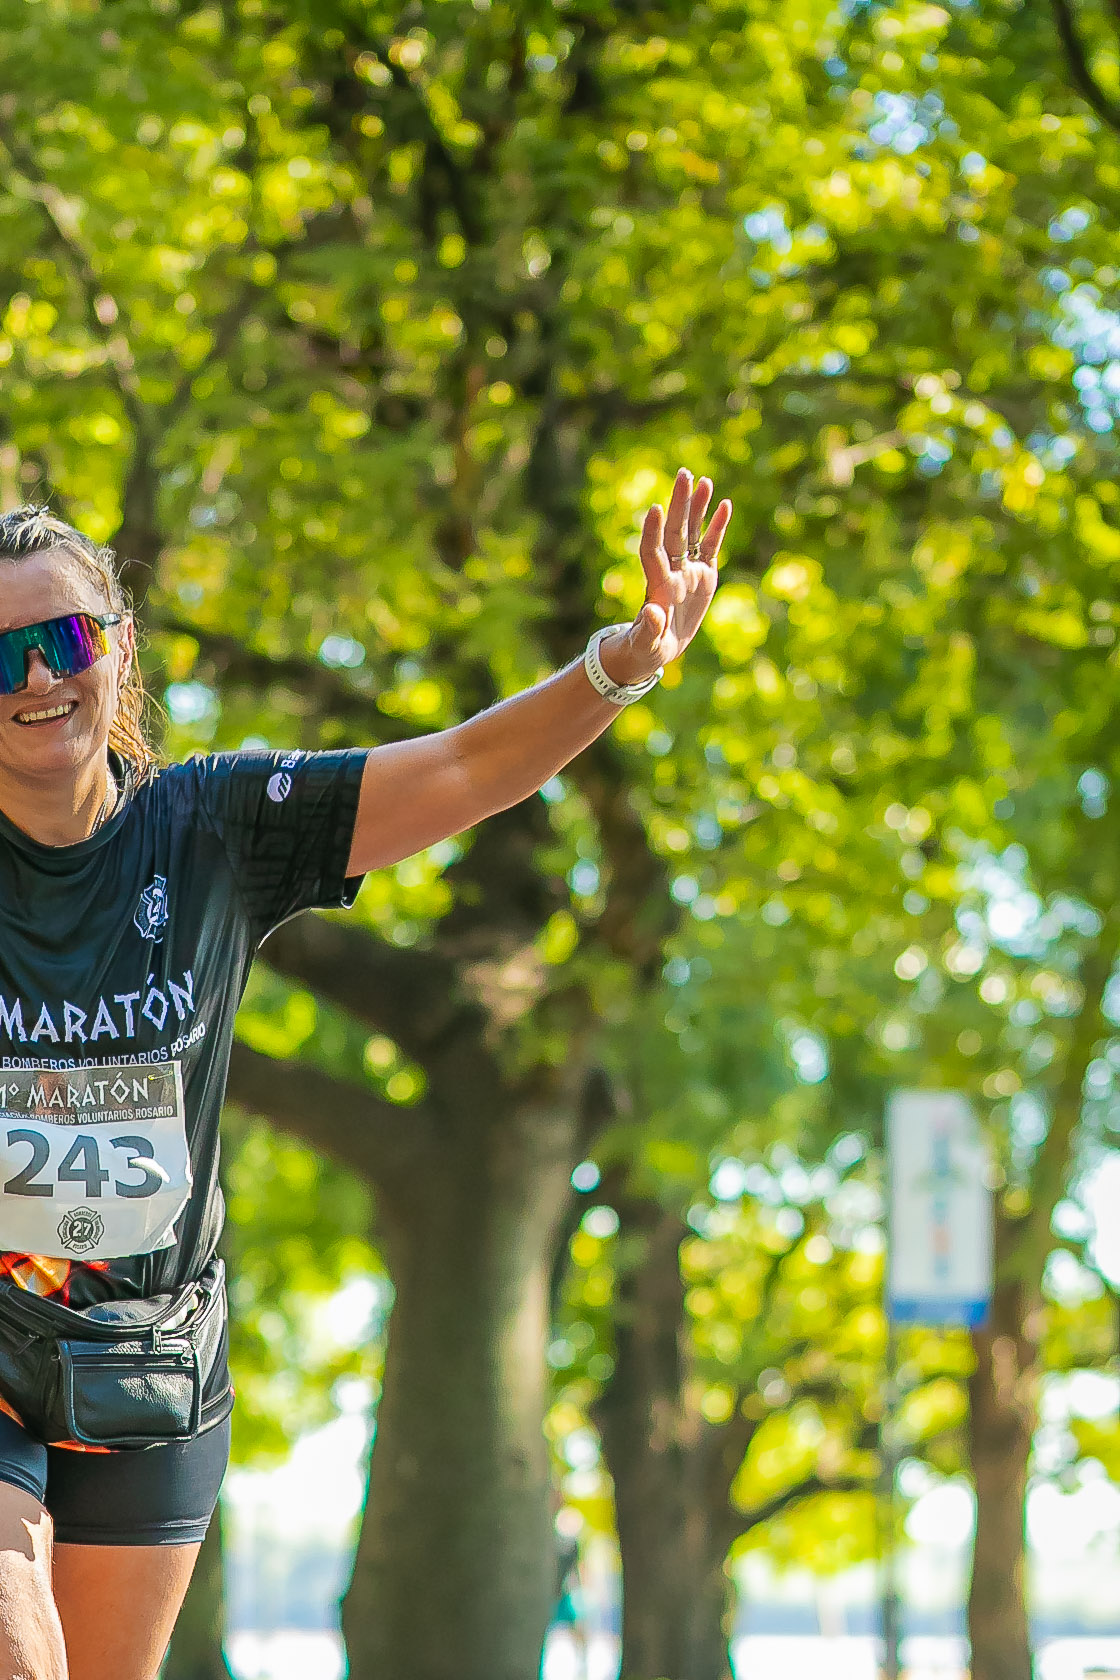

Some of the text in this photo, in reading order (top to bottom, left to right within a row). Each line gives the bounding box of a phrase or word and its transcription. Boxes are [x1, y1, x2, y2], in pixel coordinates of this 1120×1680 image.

[2, 1056, 75, 1070] BOMBEROS
[78, 1047, 168, 1067] VOLUNTARIOS
[171, 1022, 206, 1057] ROSARIO
[26, 1071, 149, 1108] MARATÓN
[77, 1109, 134, 1123] VOLUNTARIOS
[135, 1105, 173, 1118] ROSARIO
[3, 1128, 163, 1199] 243
[72, 1220, 91, 1237] 27
